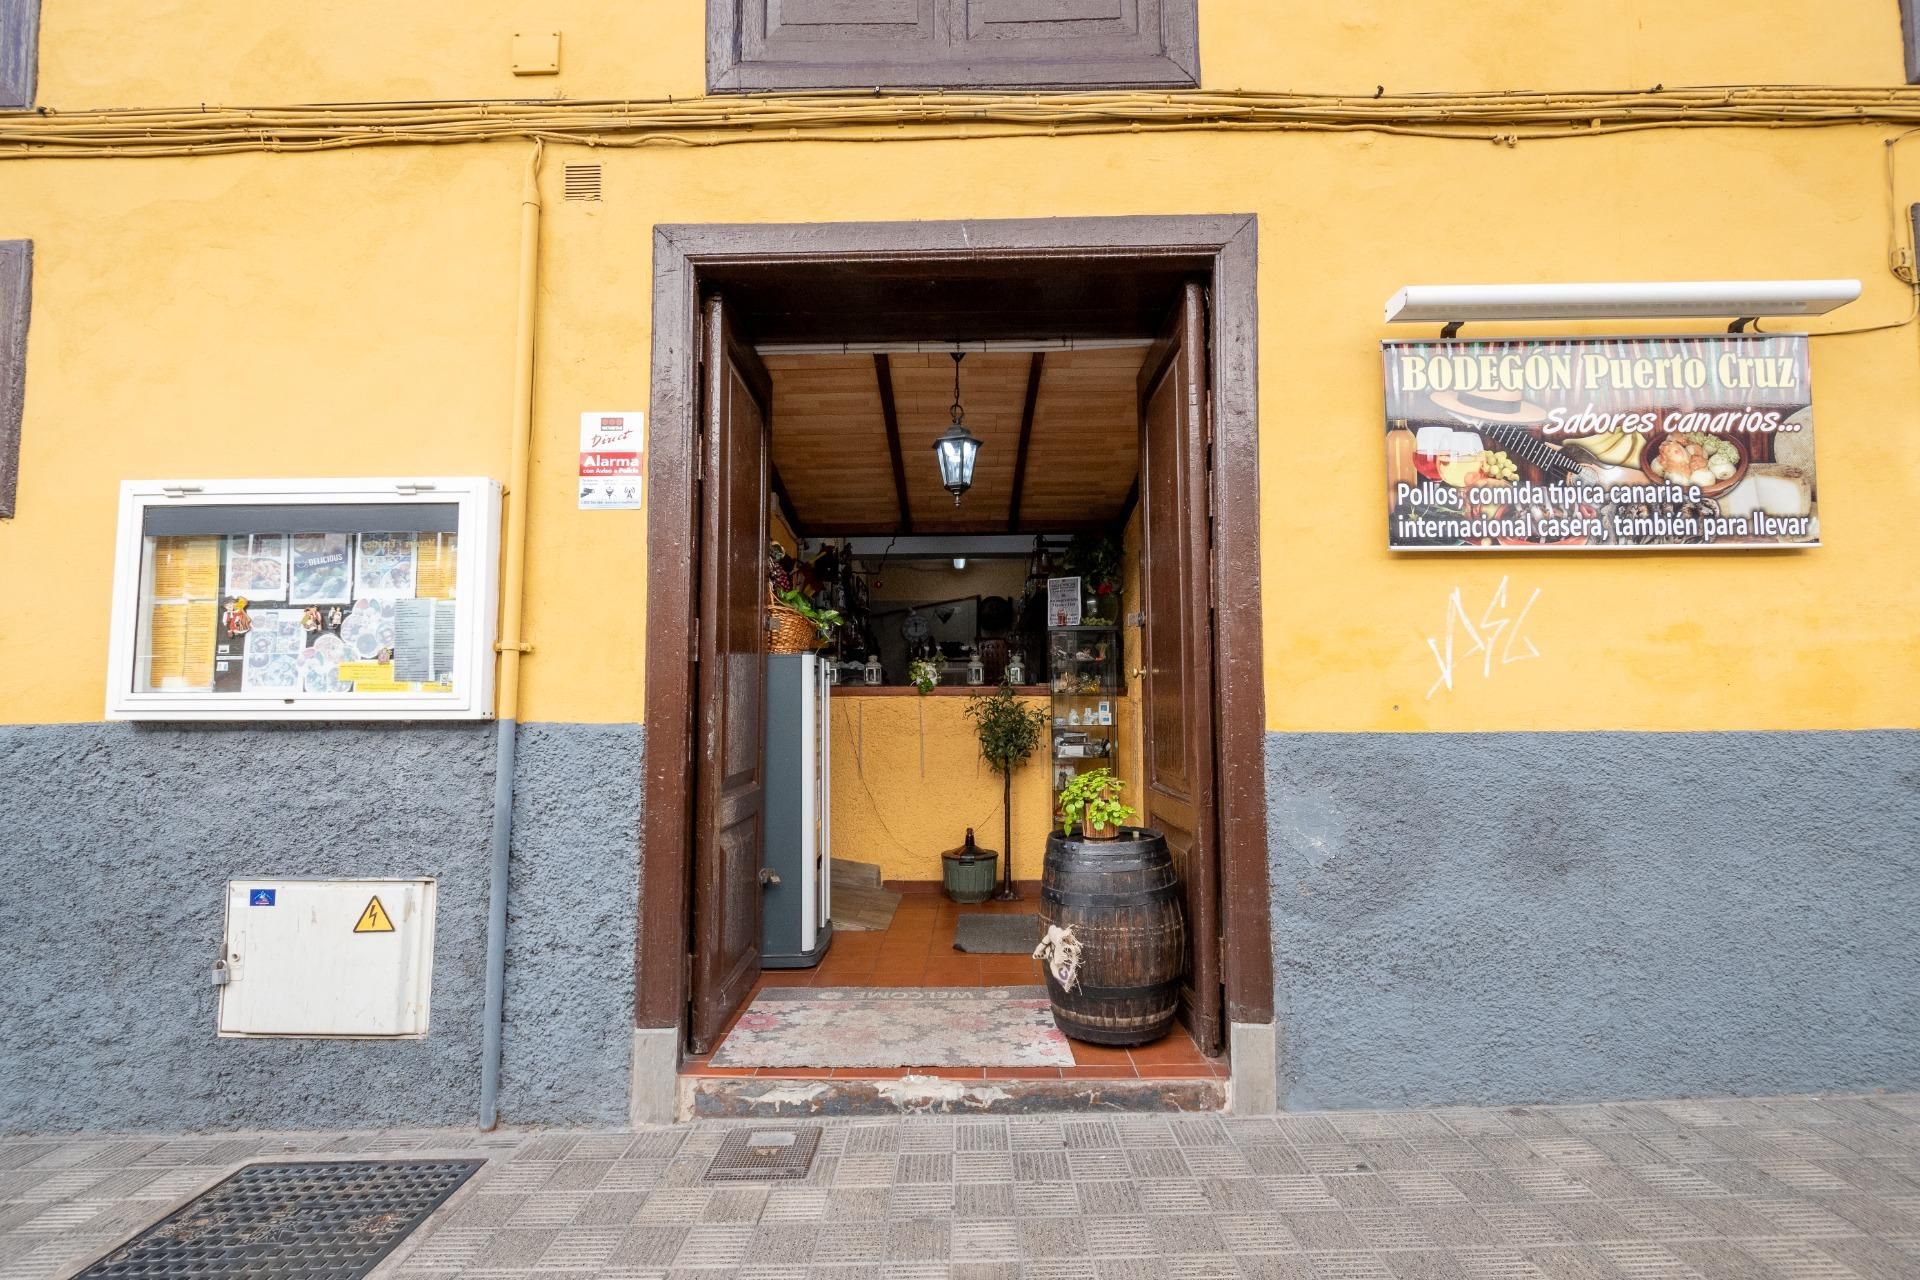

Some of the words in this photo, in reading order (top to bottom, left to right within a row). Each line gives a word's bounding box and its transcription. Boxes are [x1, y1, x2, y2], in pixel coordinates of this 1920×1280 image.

[1401, 347, 1572, 391] BODEGÓN
[1583, 353, 1706, 388] Puerto
[1718, 352, 1795, 388] Cruz
[1542, 403, 1658, 435] Sabores
[1663, 406, 1801, 433] canarios...
[583, 454, 640, 467] Alarma
[1397, 481, 1463, 508] Pollos,
[1469, 481, 1544, 504] comida
[1549, 480, 1604, 508] típica
[1611, 480, 1683, 503] canaria
[1689, 487, 1701, 503] e
[1398, 512, 1532, 538] internacional
[1538, 517, 1608, 541] casera,
[1614, 512, 1697, 536] también
[1703, 517, 1747, 541] para
[1753, 511, 1809, 536] llevar
[308, 553, 344, 567] DELICIOUS
[853, 990, 975, 999] WELCOME
